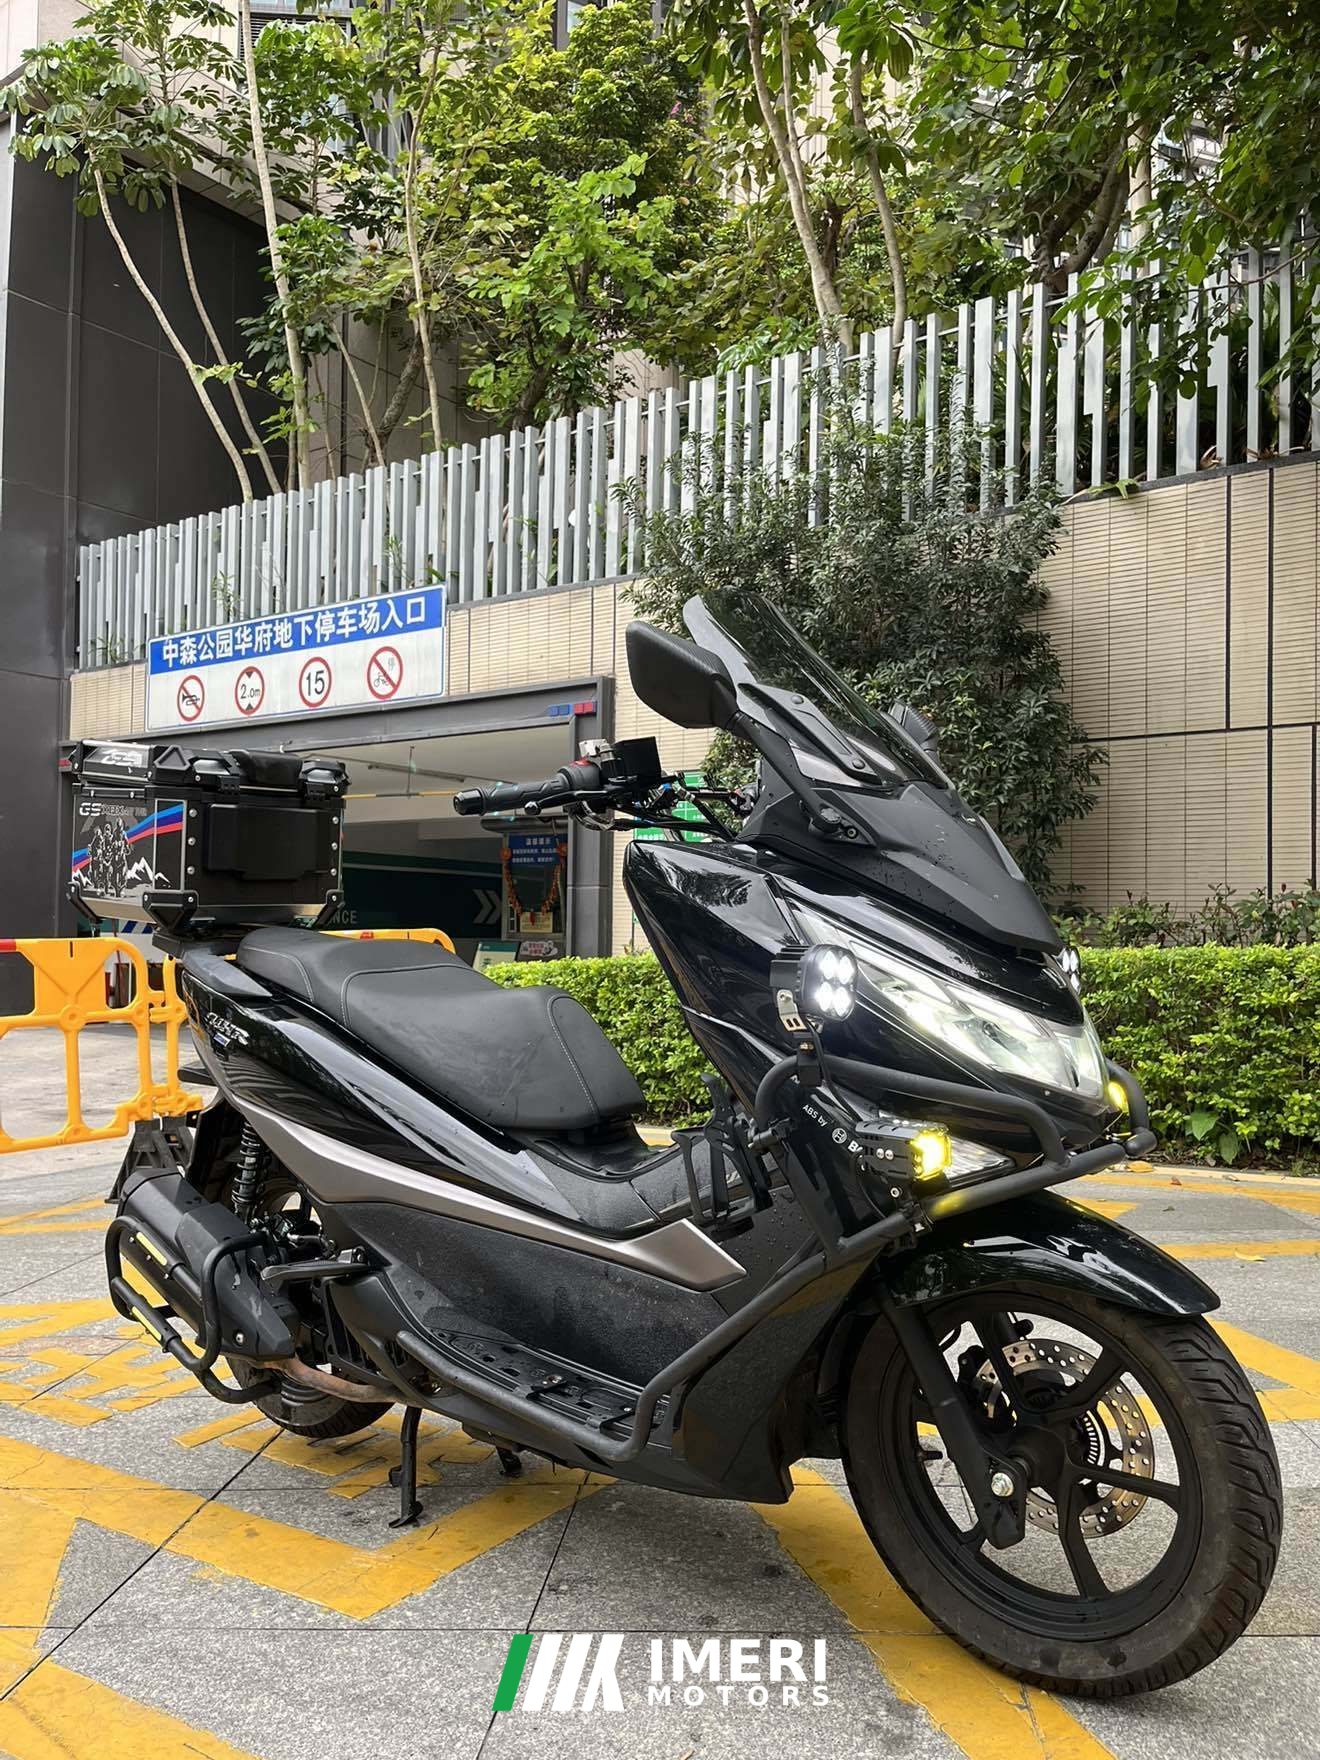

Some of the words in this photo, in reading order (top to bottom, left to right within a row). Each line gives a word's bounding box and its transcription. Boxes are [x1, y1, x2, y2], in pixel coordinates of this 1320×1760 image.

[162, 596, 426, 668] 中森公园华府地下停车场入口
[306, 670, 325, 696] 15
[802, 1104, 819, 1119] ABS
[817, 1115, 828, 1127] by
